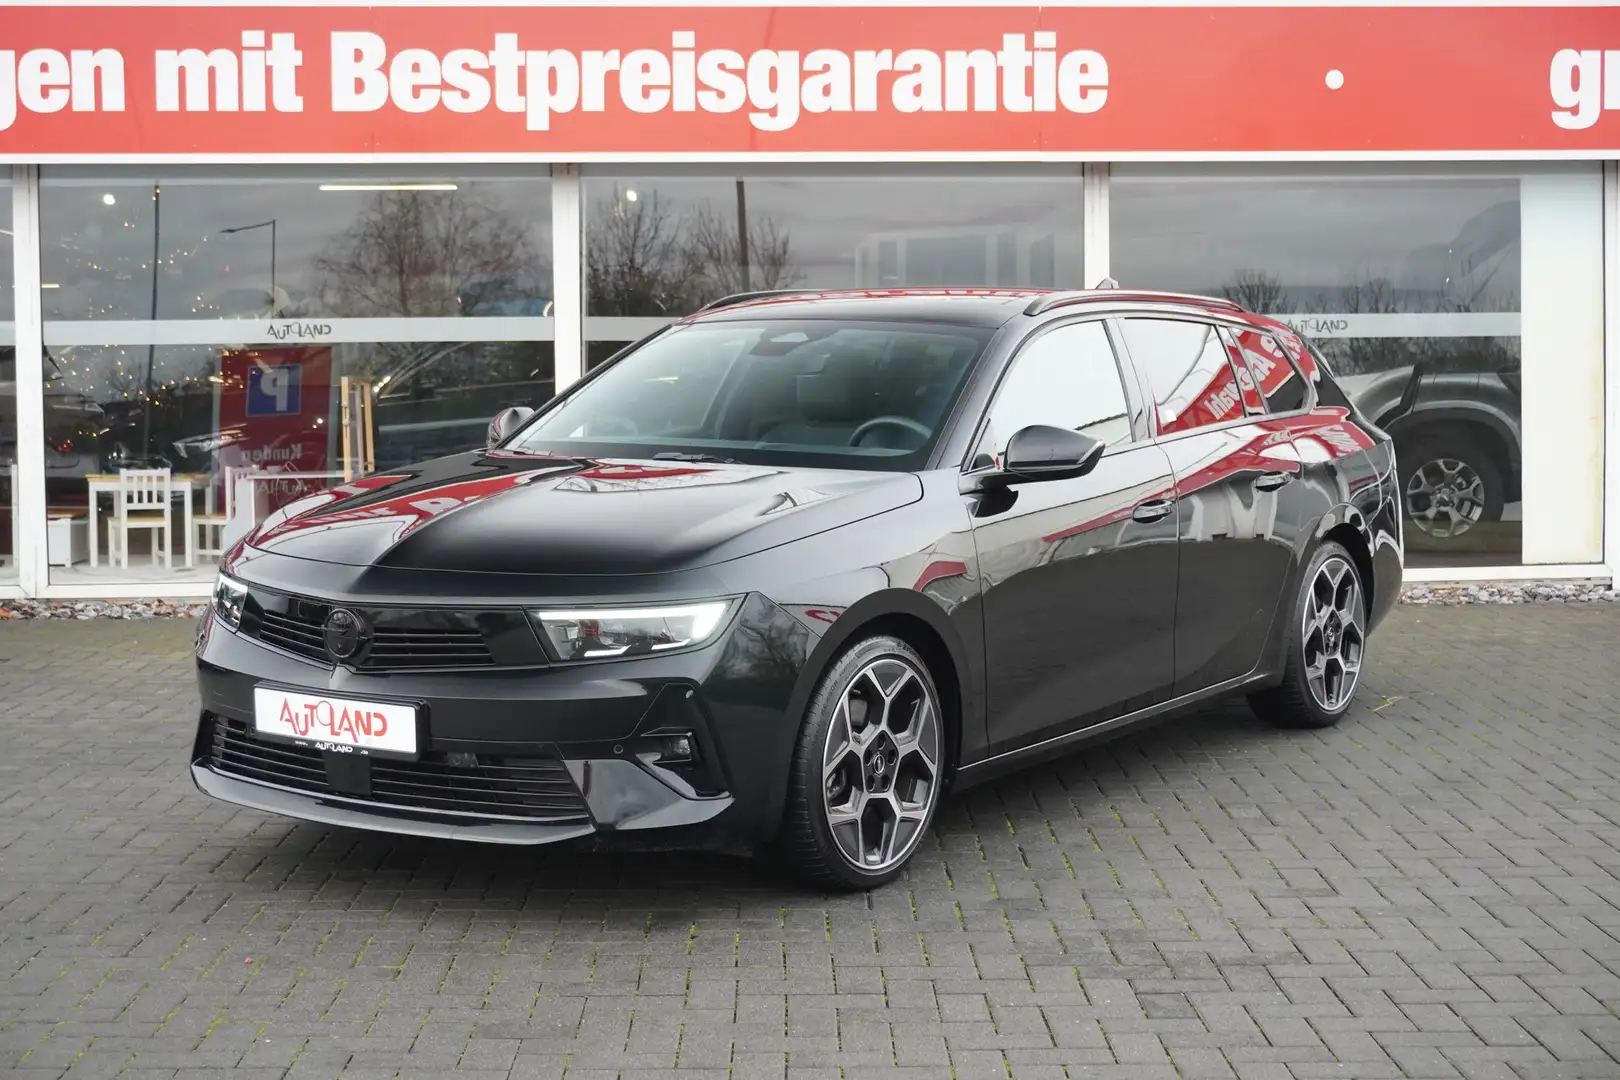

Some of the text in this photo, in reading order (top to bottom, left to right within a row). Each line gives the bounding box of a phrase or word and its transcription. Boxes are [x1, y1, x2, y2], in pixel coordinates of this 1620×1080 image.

[155, 30, 304, 112] mit
[330, 30, 1110, 131] Bestpreisgarantie
[266, 320, 332, 341] AUTOLAND
[279, 697, 388, 744] AUTOLAND
[314, 741, 354, 754] AUTOLAND
